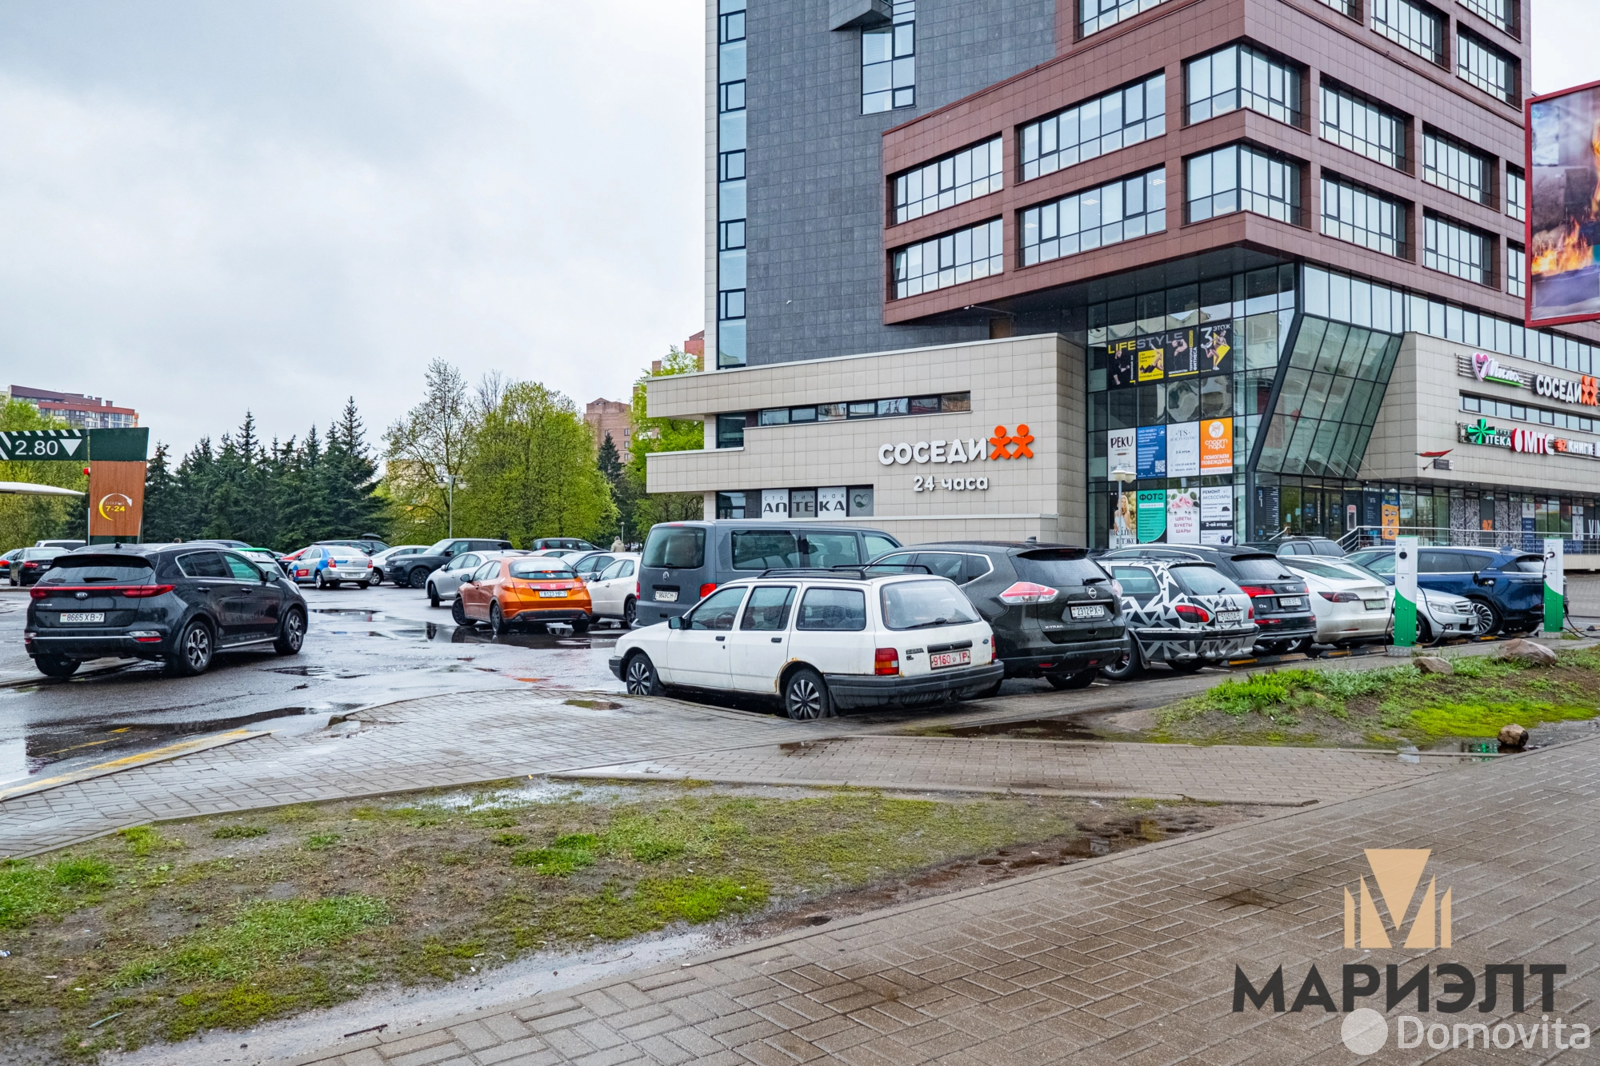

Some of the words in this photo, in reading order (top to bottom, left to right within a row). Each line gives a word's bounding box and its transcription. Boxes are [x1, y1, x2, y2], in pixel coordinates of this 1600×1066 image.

[1200, 326, 1213, 348] 3
[1534, 374, 1582, 404] СОСЕДИ
[14, 440, 58, 456] 2.80
[1524, 430, 1554, 455] МТС
[1568, 440, 1594, 456] КНИГИ
[878, 437, 988, 466] СОСЕДИ
[914, 476, 935, 492] 24
[941, 476, 989, 491] часа
[1139, 493, 1164, 501] ФОТО
[763, 500, 846, 513] АПТЕКА
[932, 654, 950, 666] 9160
